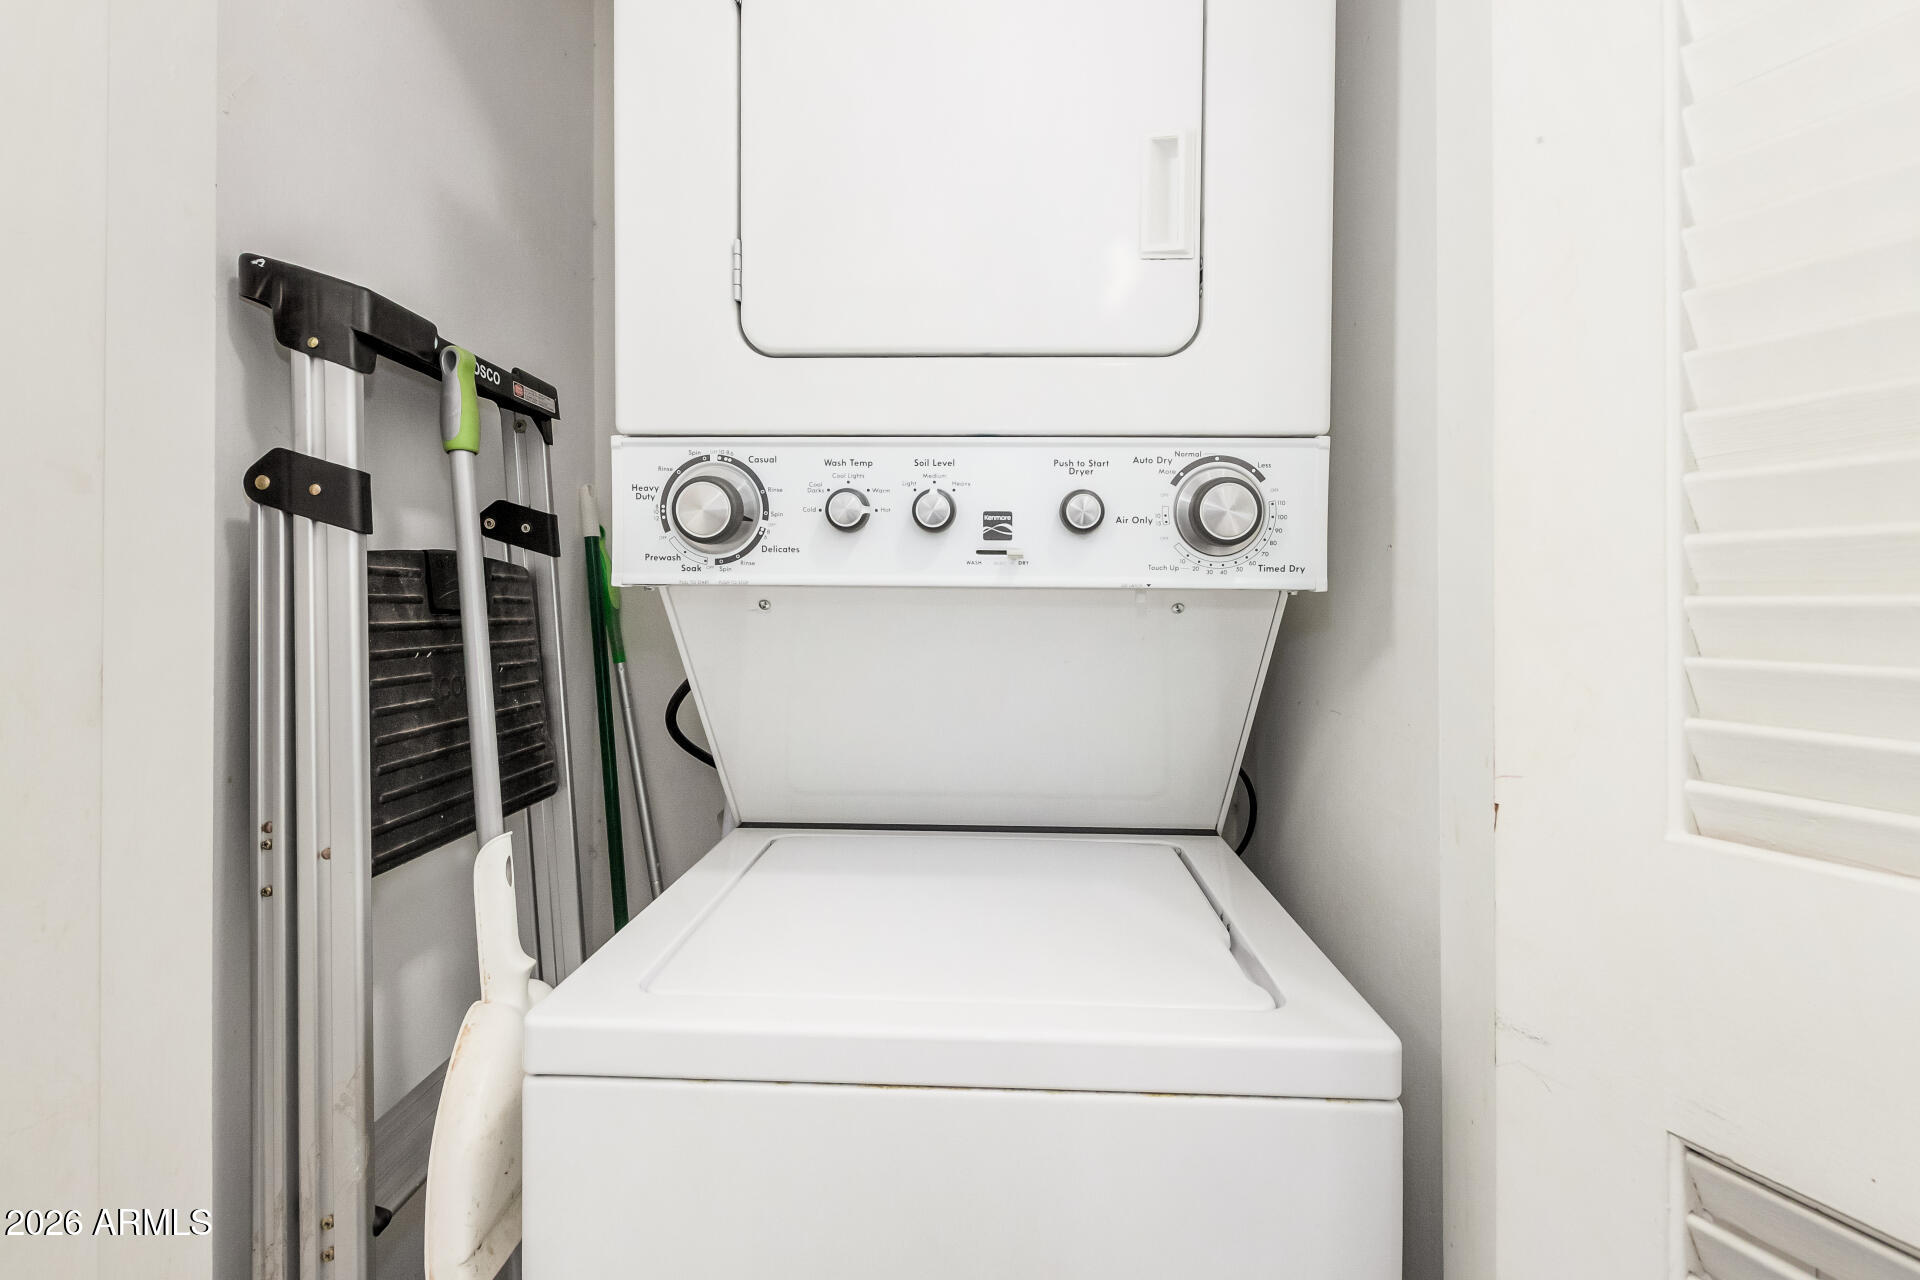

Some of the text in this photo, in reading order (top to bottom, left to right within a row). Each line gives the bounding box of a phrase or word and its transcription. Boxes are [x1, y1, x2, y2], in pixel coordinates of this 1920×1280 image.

[475, 362, 500, 385] OSCO
[748, 455, 777, 463] Casual
[914, 459, 955, 467] Soil Level
[1053, 459, 1109, 467] Push to Start
[1132, 456, 1173, 466] Auto Dry
[824, 459, 873, 468] Wash Temp
[1068, 467, 1094, 477] Dryer
[631, 484, 660, 493] Heavy
[635, 493, 656, 501] Duty
[1115, 516, 1153, 527] Air Only
[761, 545, 800, 553] Delicates
[644, 553, 682, 561] Prewash
[681, 564, 702, 572] Soak
[1169, 564, 1180, 572] Up
[1258, 564, 1306, 574] Timed Dry
